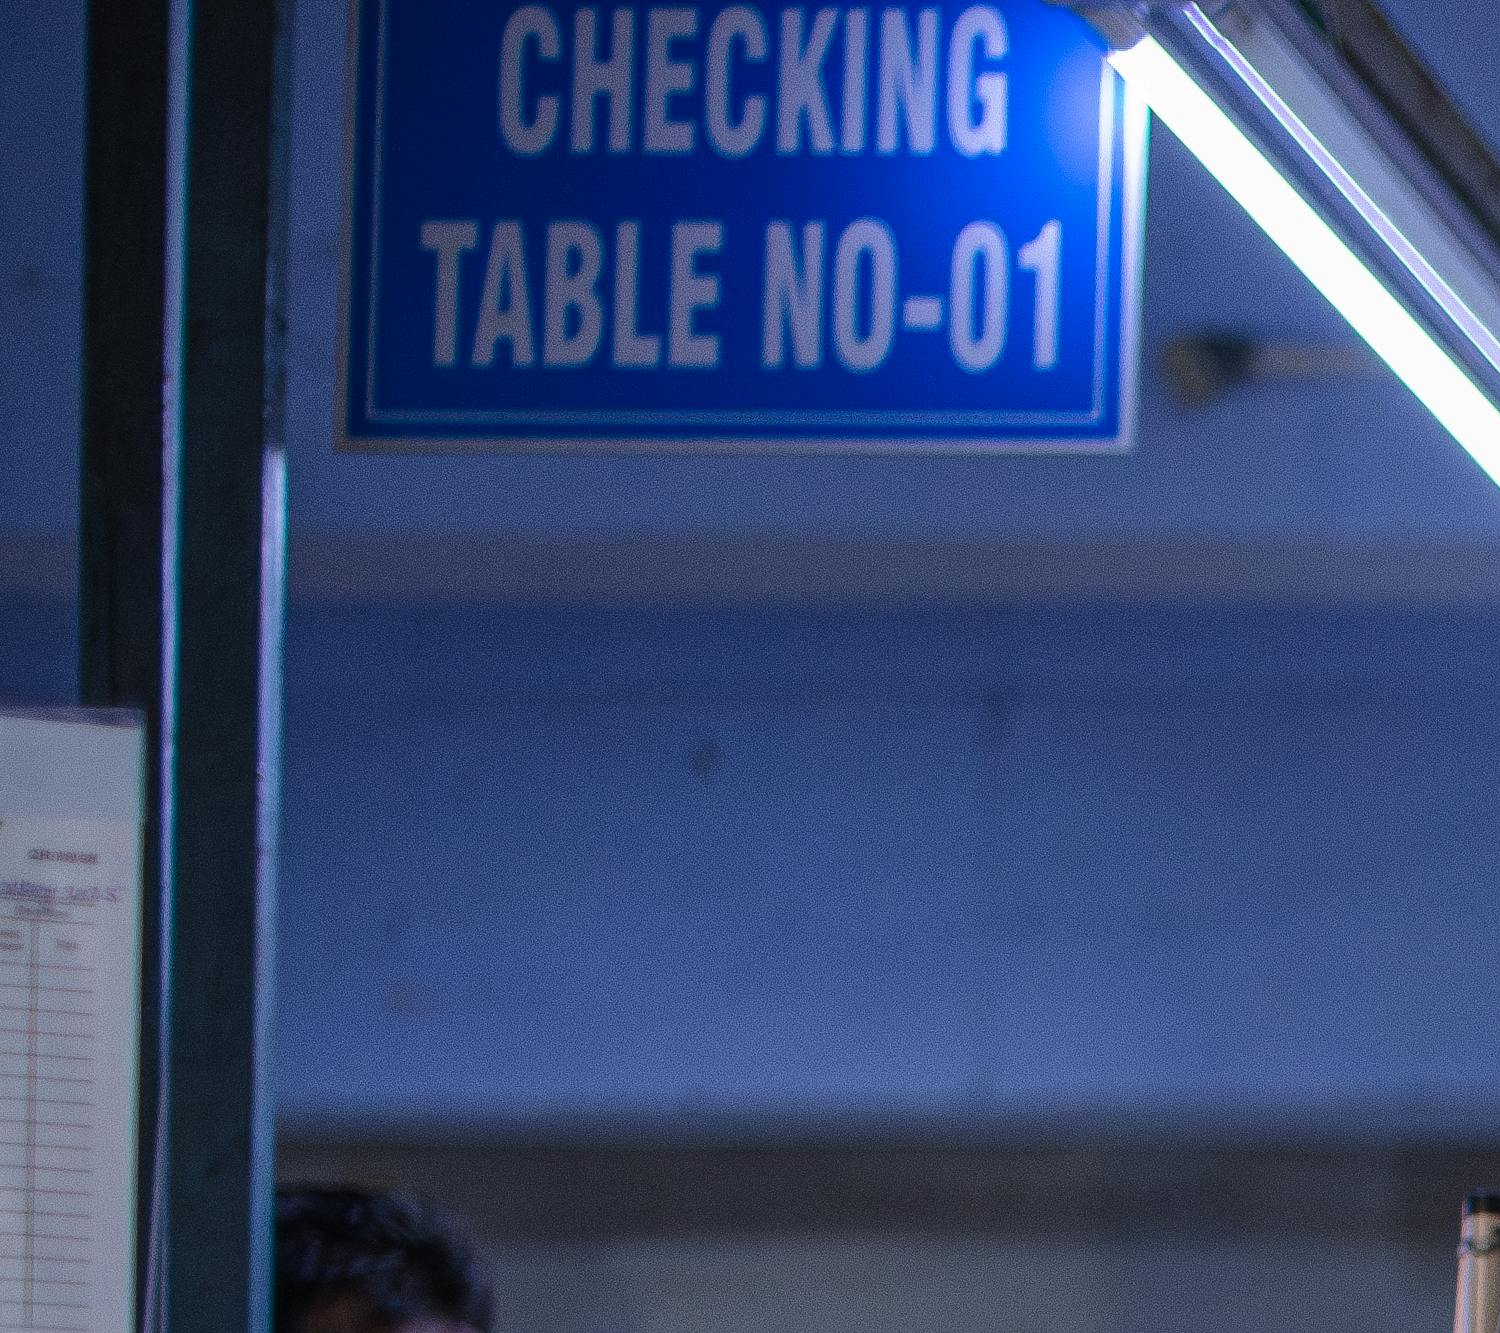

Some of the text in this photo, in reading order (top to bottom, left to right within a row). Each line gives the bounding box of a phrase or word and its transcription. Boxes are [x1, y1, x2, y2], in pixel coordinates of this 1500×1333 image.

[498, 5, 1009, 158] CHECKING
[419, 218, 1063, 373] TABLE NO-01
